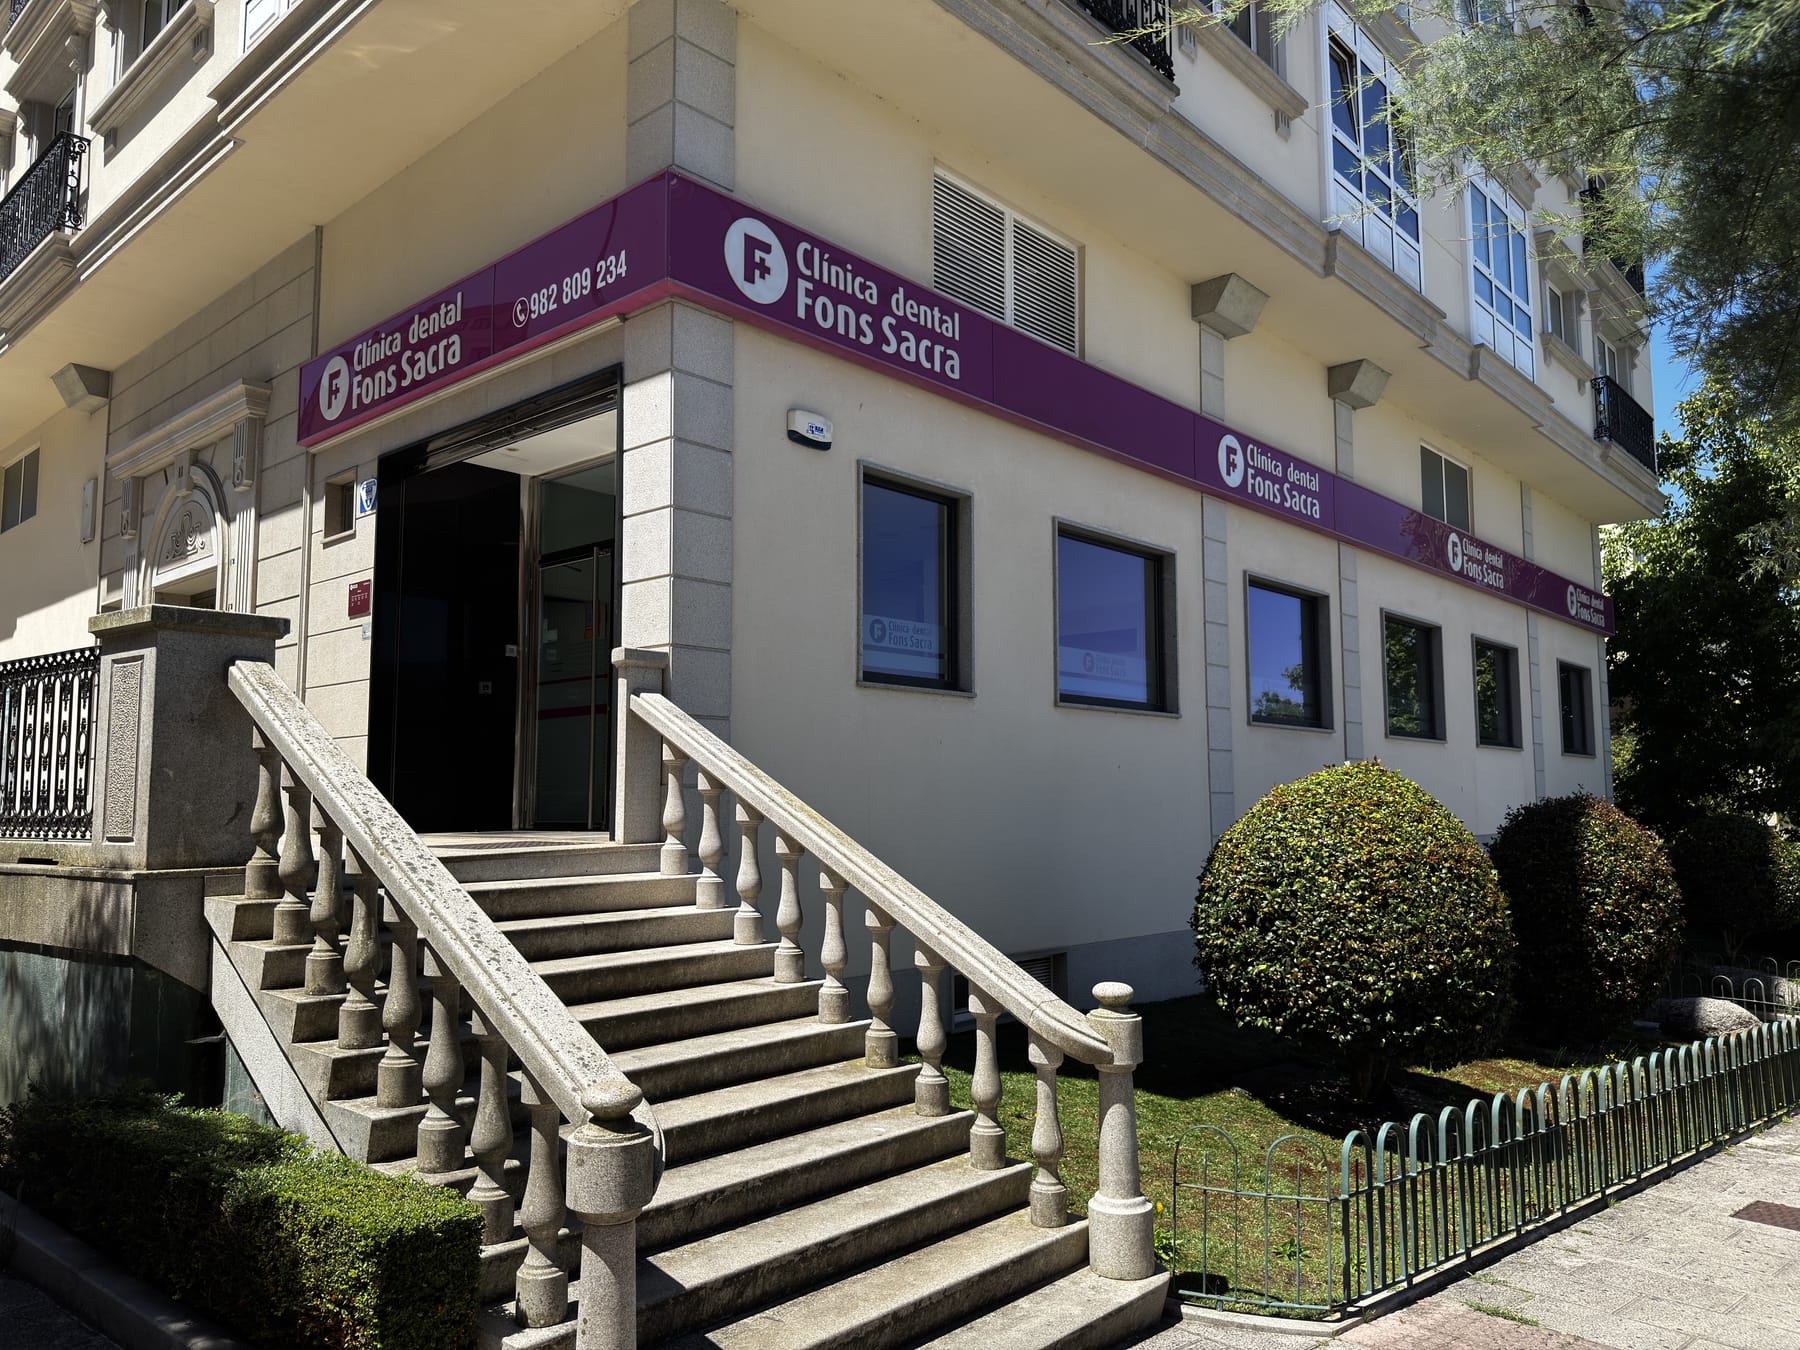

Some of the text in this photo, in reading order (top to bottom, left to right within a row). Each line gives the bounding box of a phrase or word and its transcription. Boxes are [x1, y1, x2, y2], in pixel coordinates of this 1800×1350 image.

[530, 249, 627, 320] 982 809 234
[796, 241, 960, 341] Clínica dental
[353, 291, 463, 372] Clínica dental
[796, 278, 960, 380] Fons Sacra
[352, 334, 461, 410] Fons Sacra
[1247, 444, 1319, 493] Clínica dental
[1247, 467, 1320, 519] Fons Sacra
[1462, 538, 1503, 569] Clínica dental
[1463, 555, 1504, 589] Fons Sacra
[1577, 604, 1591, 622] Fons
[888, 632, 933, 650] Fons Sacra
